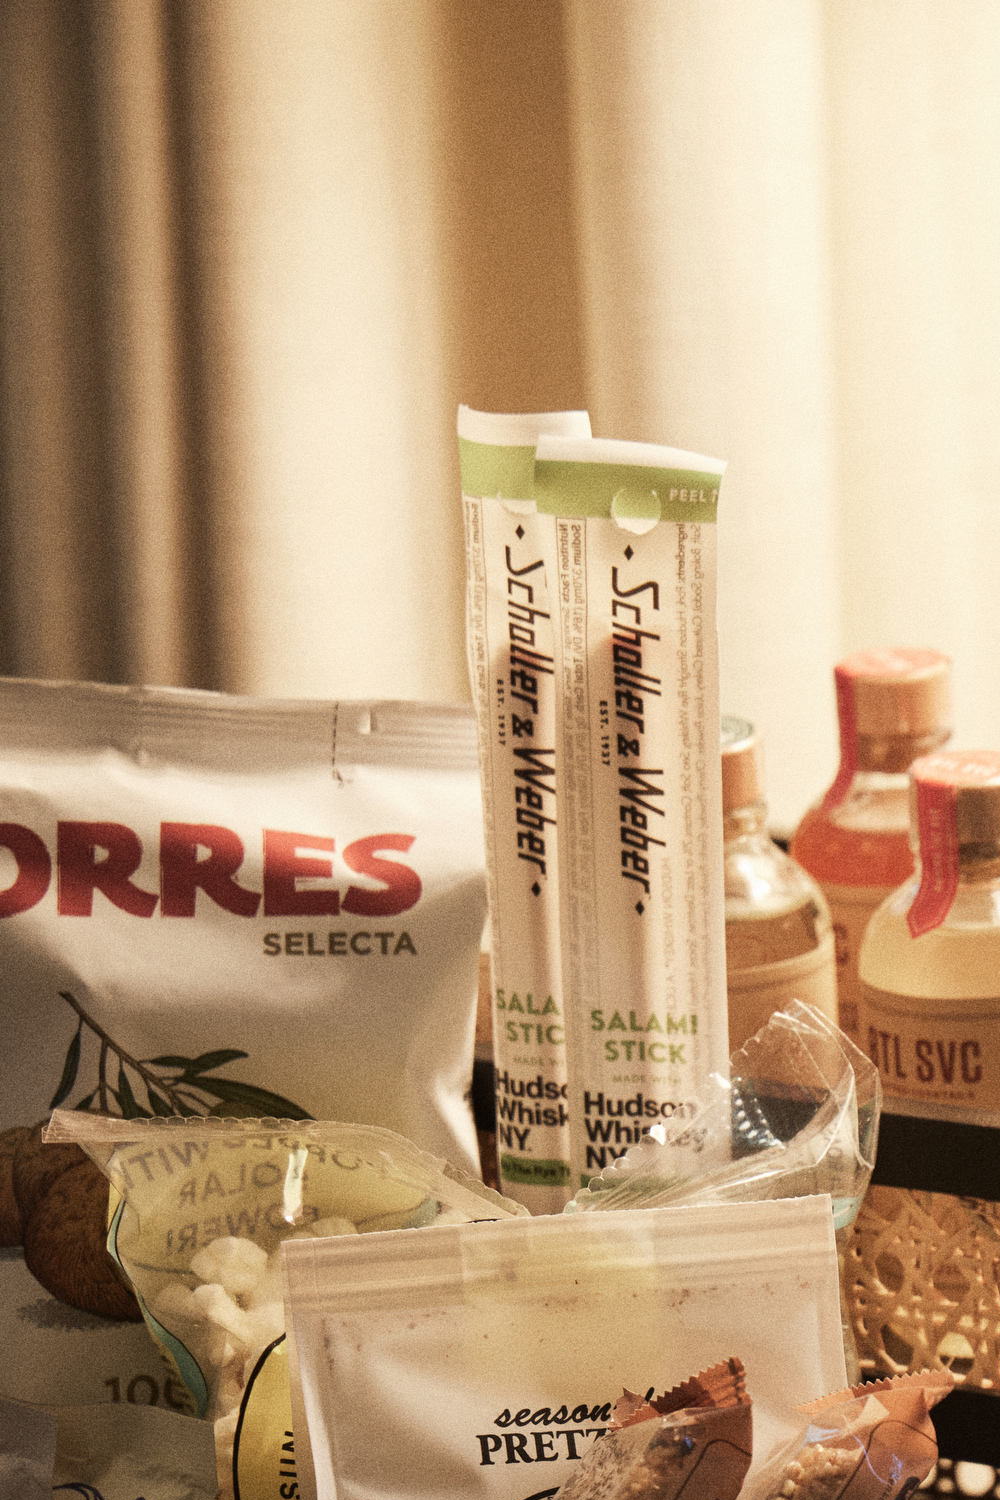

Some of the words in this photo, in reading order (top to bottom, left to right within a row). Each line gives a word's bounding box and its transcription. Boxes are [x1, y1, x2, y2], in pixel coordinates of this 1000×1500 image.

[669, 488, 706, 503] PEEL
[512, 713, 535, 738] &
[600, 700, 609, 729] EST.
[498, 714, 506, 746] 1937
[601, 735, 611, 767] 1937
[617, 733, 641, 758] &
[513, 747, 557, 881] Weber
[617, 766, 667, 895] Weber
[262, 931, 418, 957] SELECTA
[496, 989, 560, 1016] SALA
[506, 1020, 566, 1045] STIC
[591, 1009, 698, 1035] SALAMI
[604, 1040, 687, 1065] STICK
[916, 1039, 983, 1084] SVC
[612, 1074, 647, 1084] MADE
[584, 1090, 701, 1120] Hudson
[494, 1400, 620, 1429] season
